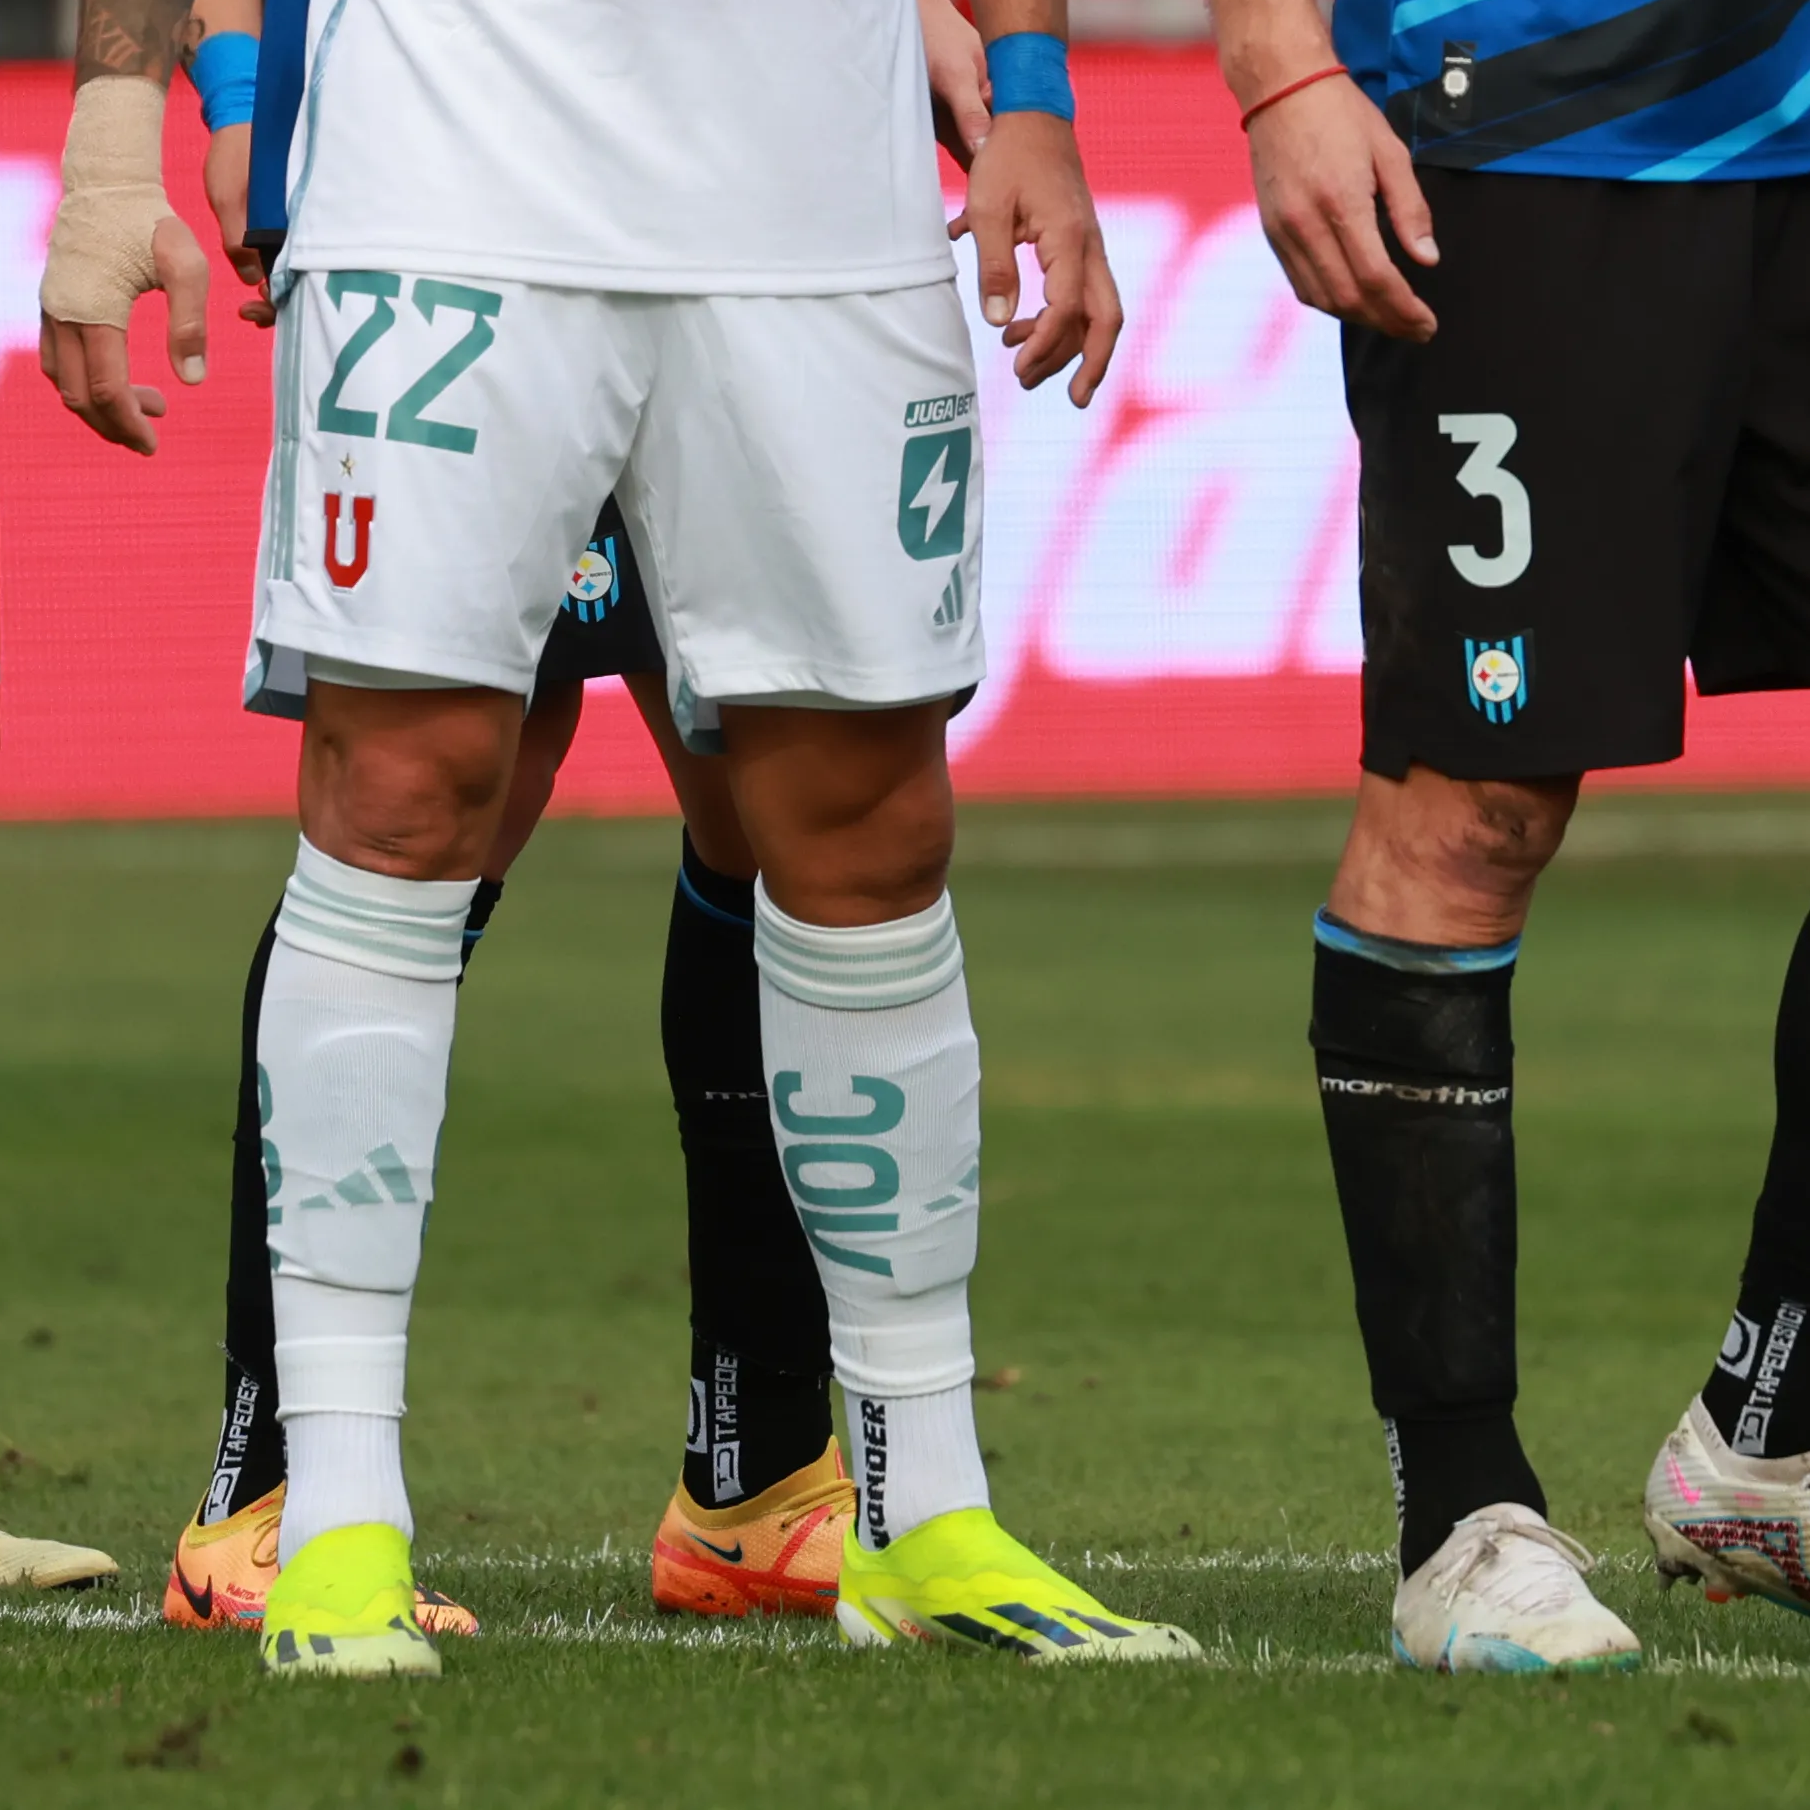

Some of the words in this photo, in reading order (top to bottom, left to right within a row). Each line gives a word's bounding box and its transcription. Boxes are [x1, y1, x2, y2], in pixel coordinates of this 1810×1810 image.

[317, 270, 503, 455] 22
[324, 493, 375, 589] U
[1438, 413, 1533, 588] 3
[221, 1374, 261, 1468] TAPEDES
[715, 1353, 739, 1441] TAPEDE
